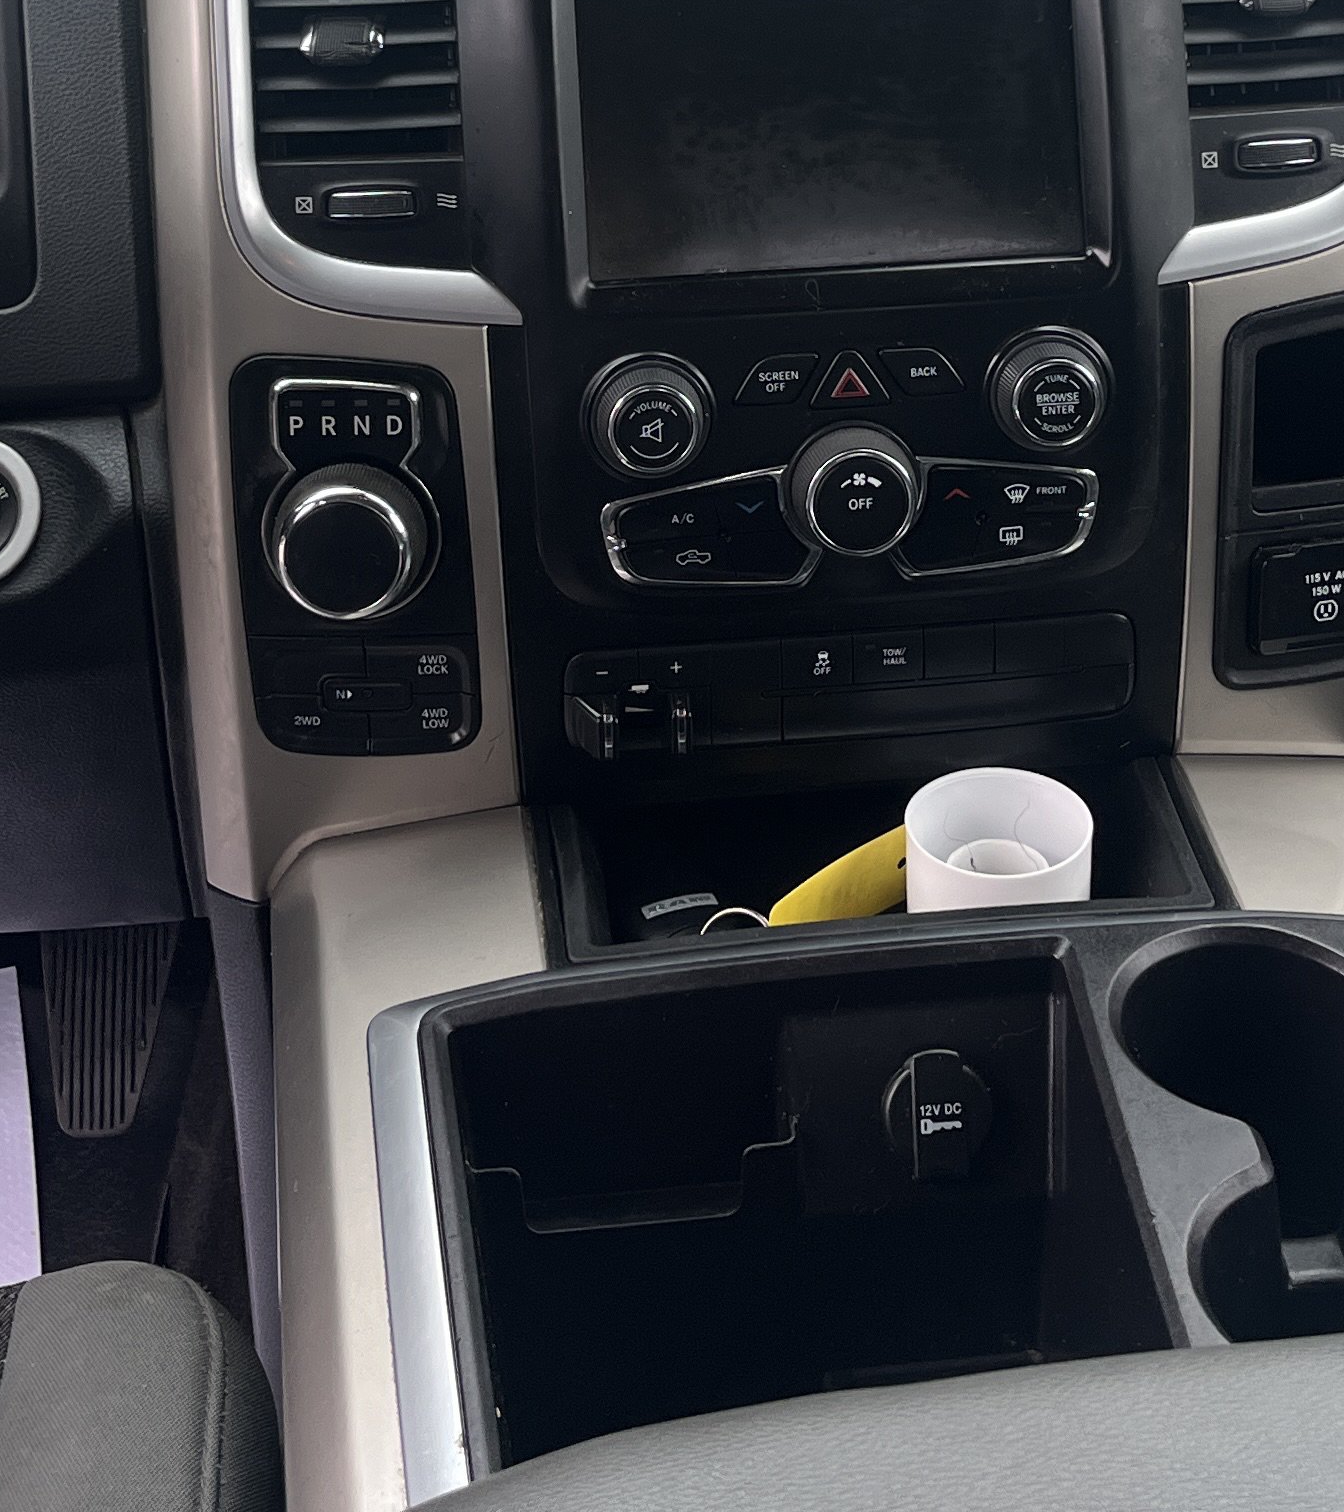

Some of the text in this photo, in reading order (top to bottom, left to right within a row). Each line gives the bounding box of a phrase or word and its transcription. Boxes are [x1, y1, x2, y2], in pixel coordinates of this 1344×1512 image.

[758, 370, 799, 384] SCREEN
[910, 366, 938, 378] BACK
[1045, 374, 1069, 384] TUNE
[766, 381, 787, 393] OFF
[1036, 392, 1080, 403] BROWSE
[633, 401, 671, 415] VOLUME
[1042, 405, 1075, 416] ENTER
[289, 415, 403, 436] P R N D
[1041, 422, 1074, 433] SCROLL
[1036, 486, 1067, 495] FRONT
[848, 497, 873, 511] OFF
[671, 513, 695, 524] A/C
[1305, 574, 1321, 585] 115
[1322, 572, 1331, 583] V
[1312, 584, 1342, 596] 150 W
[883, 647, 907, 659] TOW/
[419, 655, 447, 665] 4WD
[883, 656, 907, 667] HAUL
[418, 664, 448, 675] LOCK
[813, 665, 831, 676] OFF
[336, 689, 346, 699] N
[421, 708, 449, 718] 4WD
[294, 716, 321, 726] 2WD
[422, 718, 450, 729] LOW
[920, 1102, 962, 1117] 12V DC
